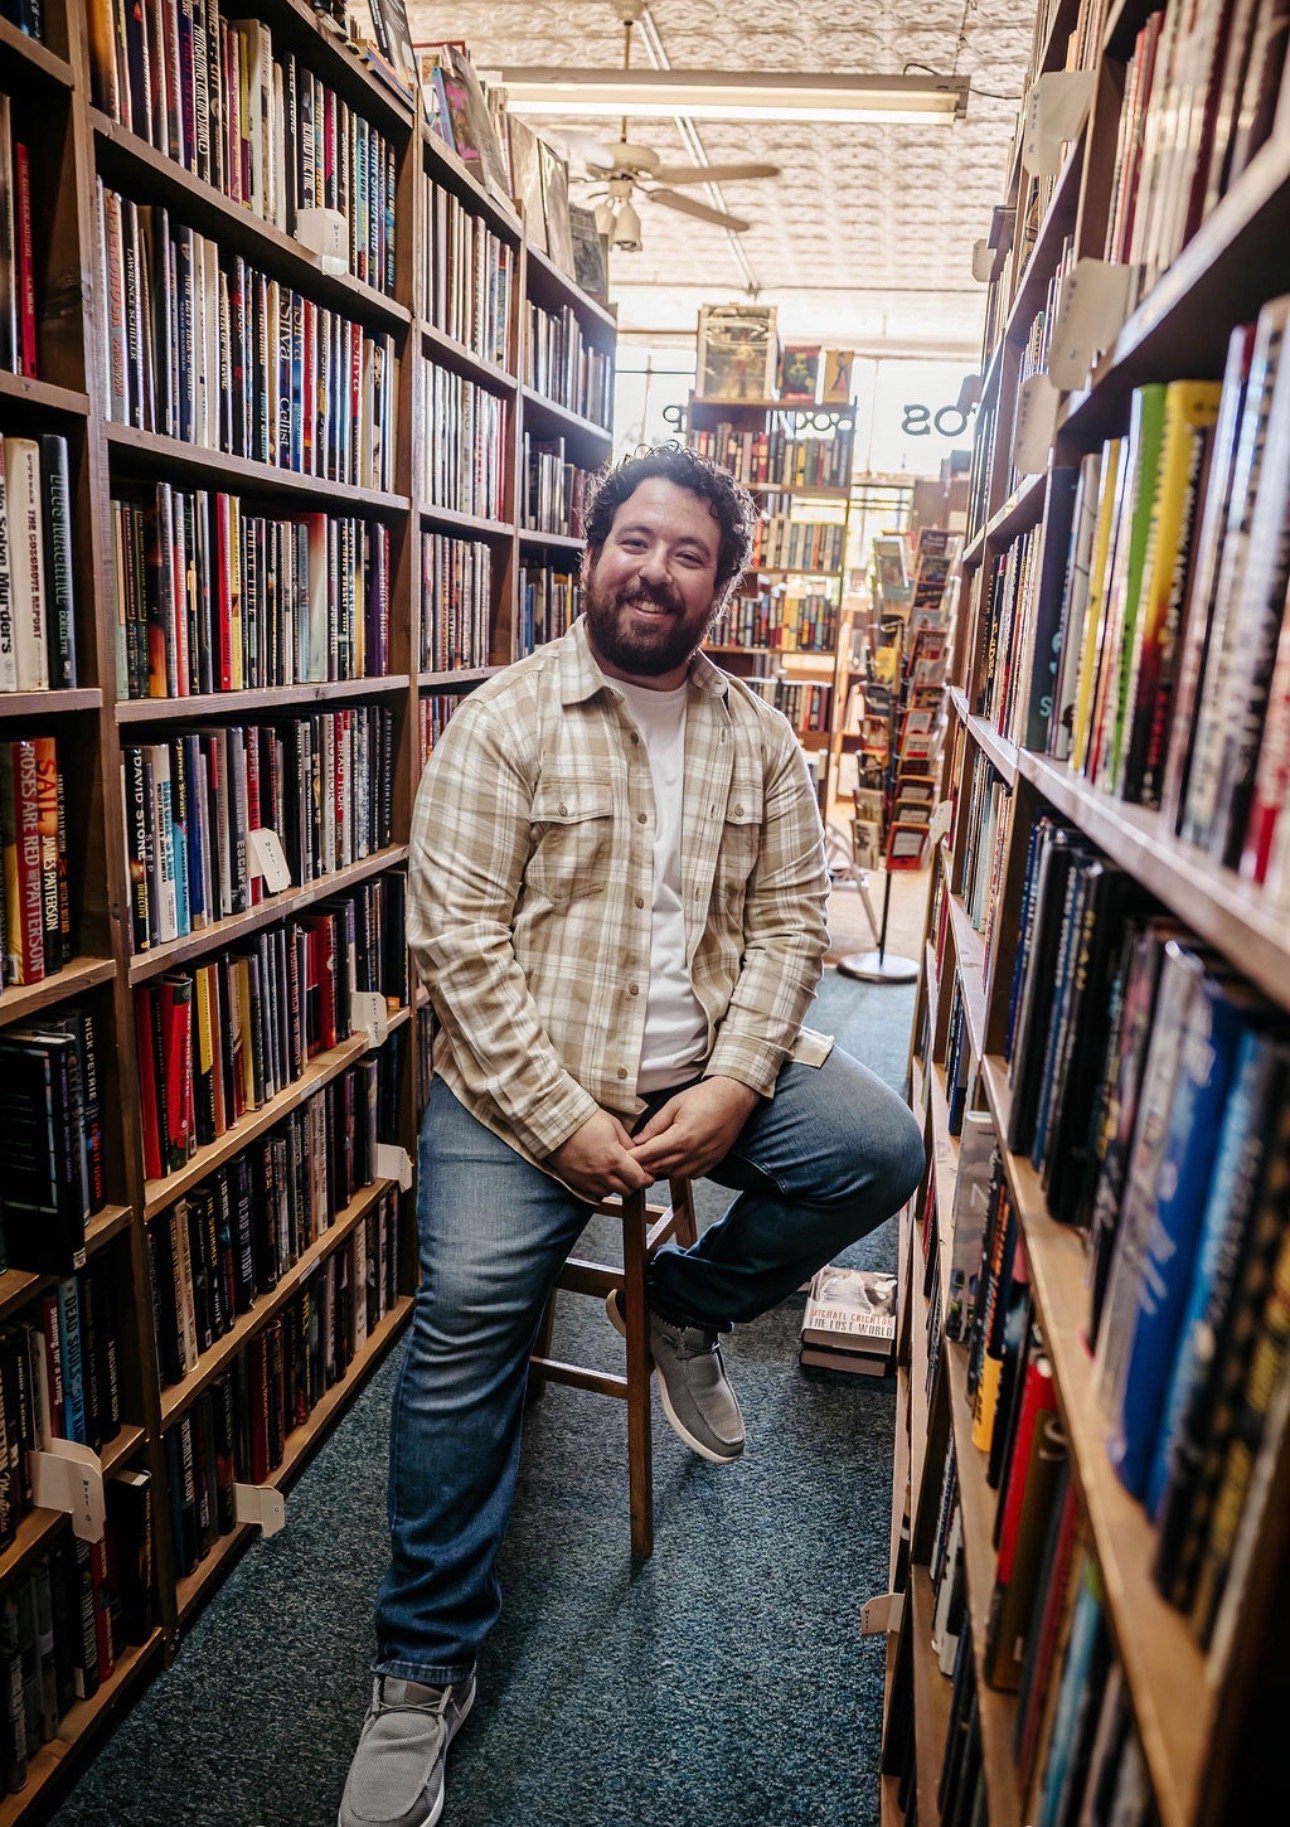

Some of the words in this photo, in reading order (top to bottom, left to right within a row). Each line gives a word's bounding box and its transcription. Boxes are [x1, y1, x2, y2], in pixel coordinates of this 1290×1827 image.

[127, 248, 136, 304] LAWRENCE
[129, 309, 137, 360] SCHILLER
[280, 302, 292, 362] Silva
[280, 398, 291, 448] Cellist
[28, 510, 36, 531] THE
[29, 533, 39, 593] COSGROVE
[0, 571, 13, 655] Murders
[32, 595, 42, 640] REPORT
[19, 746, 38, 800] ROSES
[133, 756, 144, 803] DAVID
[249, 735, 257, 782] TAPPER
[37, 760, 57, 823] SAIL
[178, 783, 186, 818] Swain
[337, 779, 345, 811] THOR
[22, 800, 41, 832] ARE
[135, 809, 147, 862] STONE
[24, 835, 42, 866] RED
[42, 835, 56, 870] JAMES
[238, 841, 248, 892] ESCAPE
[44, 871, 60, 932] PATTERSON
[26, 881, 46, 977] PATTERSON
[84, 1016, 95, 1049] NICK
[87, 1052, 97, 1101] PETRIE
[241, 1245, 253, 1284] NIGHT
[49, 1307, 60, 1348] Stealing
[64, 1295, 78, 1332] DEAD
[808, 1309, 846, 1321] MICHAEL
[851, 1313, 893, 1326] CRICHTON
[809, 1318, 825, 1328] THE
[829, 1320, 853, 1331] LOST
[858, 1323, 893, 1337] WORLD
[67, 1338, 80, 1379] SOULS
[53, 1374, 64, 1406] Living
